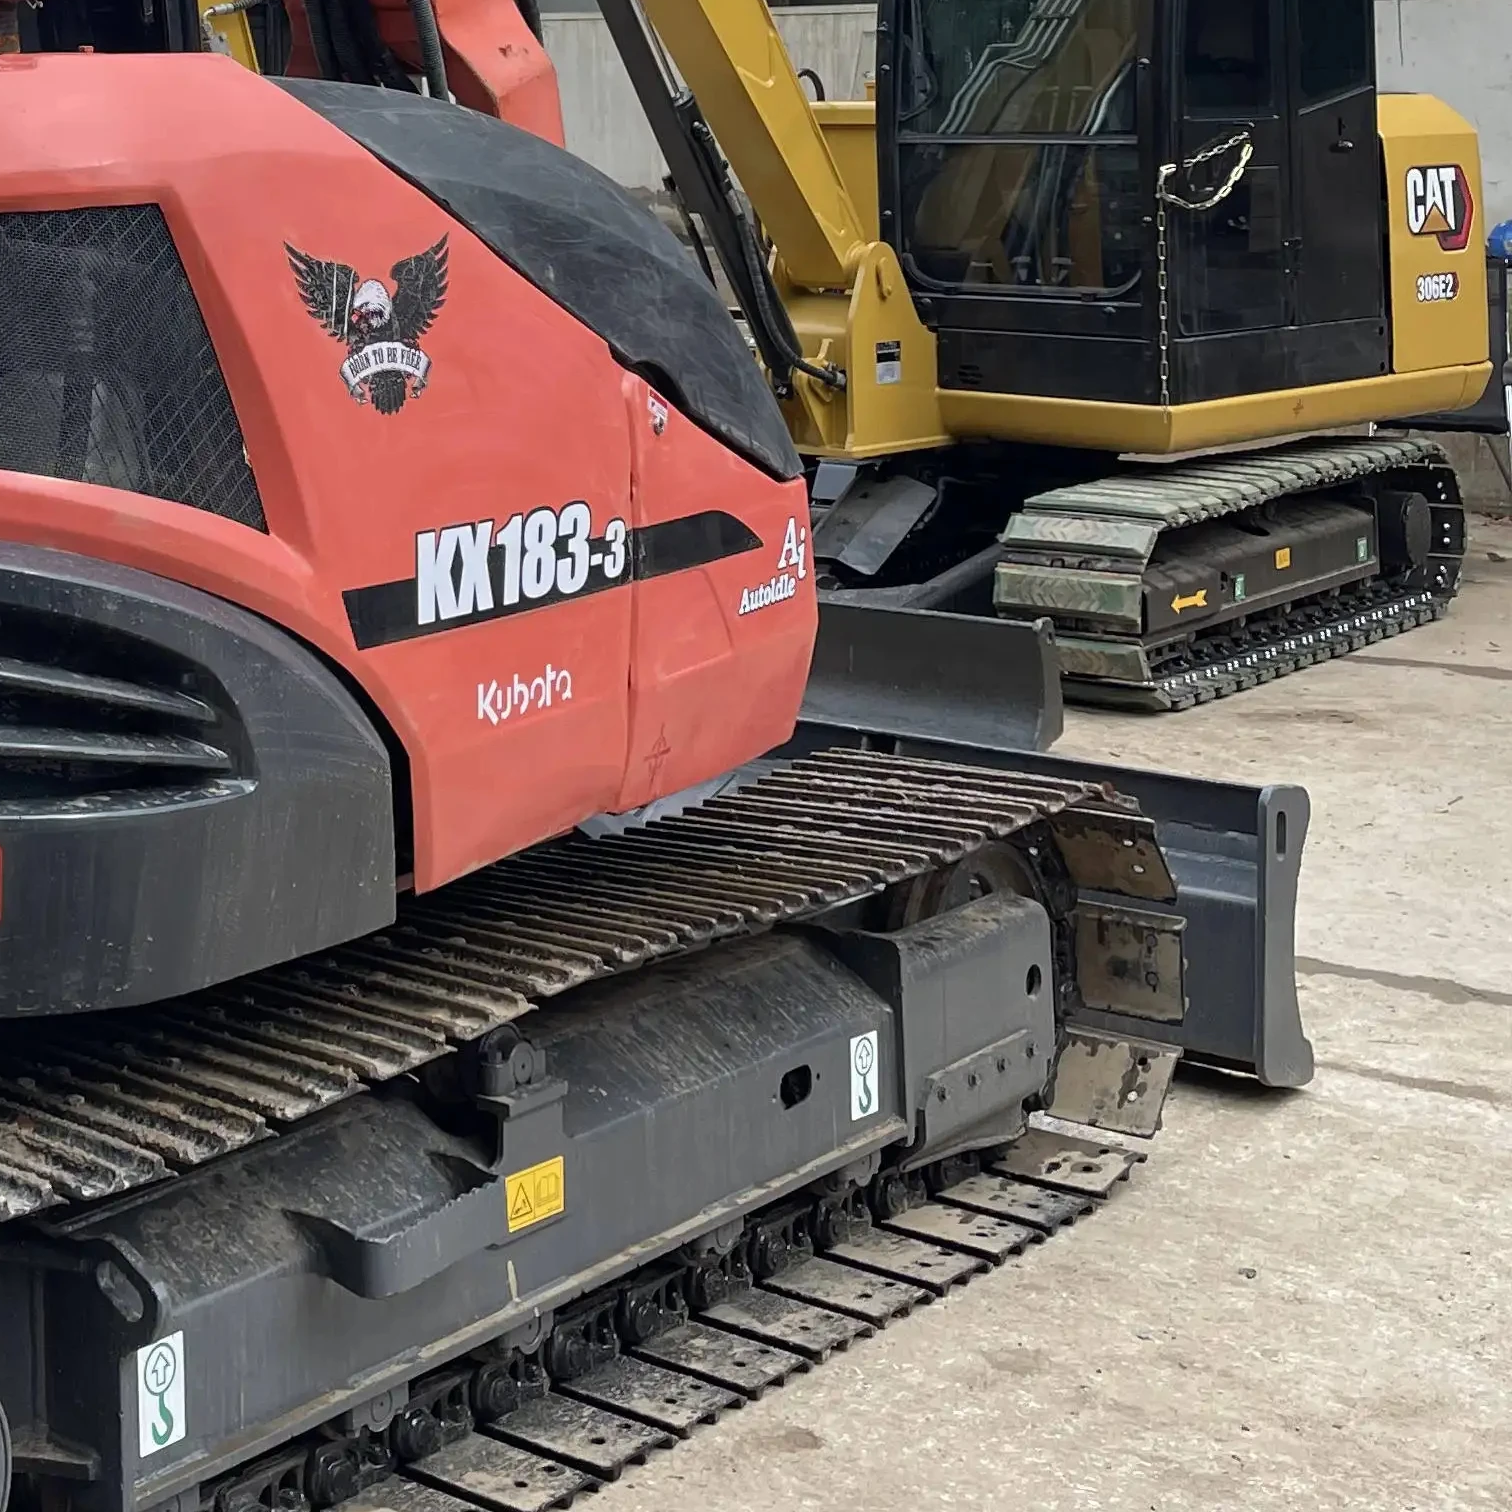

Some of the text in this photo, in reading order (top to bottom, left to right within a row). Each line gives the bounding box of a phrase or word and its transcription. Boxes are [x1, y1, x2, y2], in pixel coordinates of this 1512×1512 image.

[1406, 167, 1457, 234] CAT
[1416, 273, 1455, 302] 306E2
[372, 347, 384, 365] TO
[386, 346, 398, 363] BE
[400, 347, 422, 370] FREE
[416, 502, 626, 626] KX183-3
[476, 663, 573, 726] Kubota
